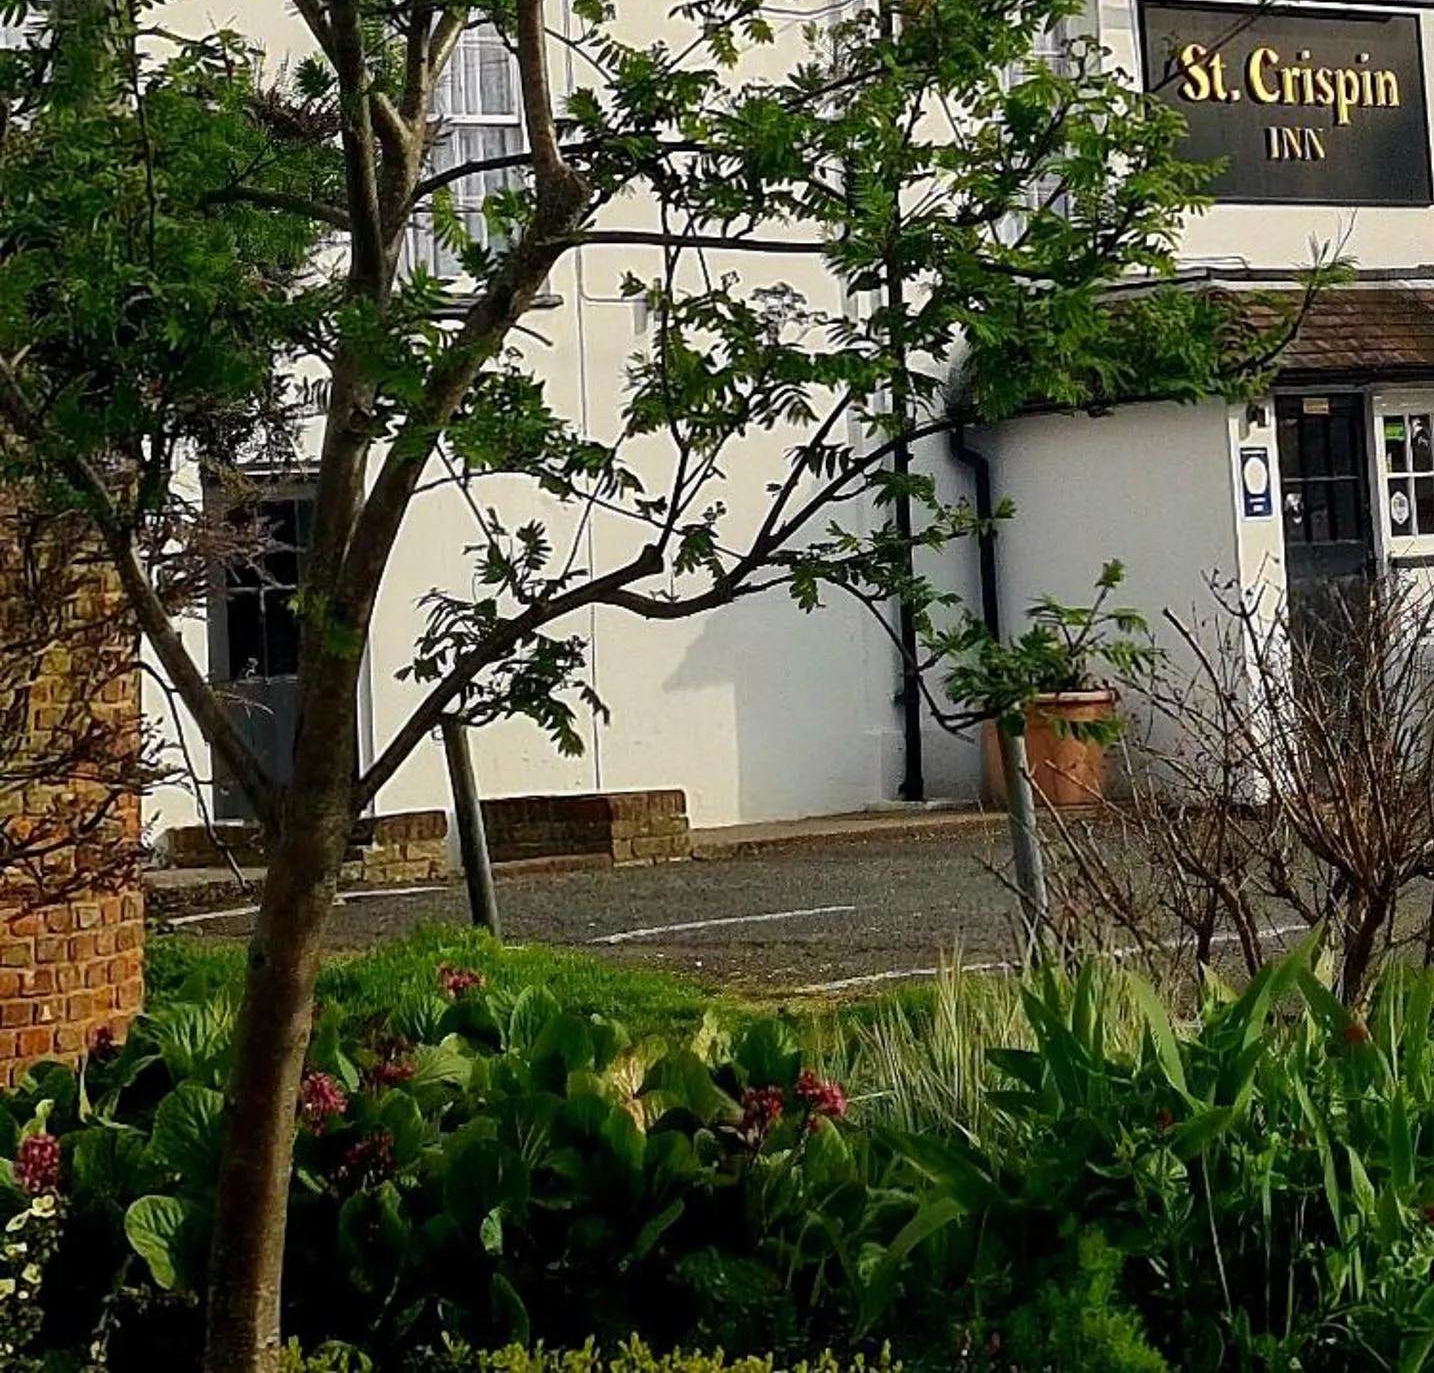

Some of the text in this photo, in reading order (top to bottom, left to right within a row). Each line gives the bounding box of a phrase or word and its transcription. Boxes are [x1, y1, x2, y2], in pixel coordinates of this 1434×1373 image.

[1180, 43, 1400, 126] St. Crispin
[1265, 127, 1326, 161] INN
